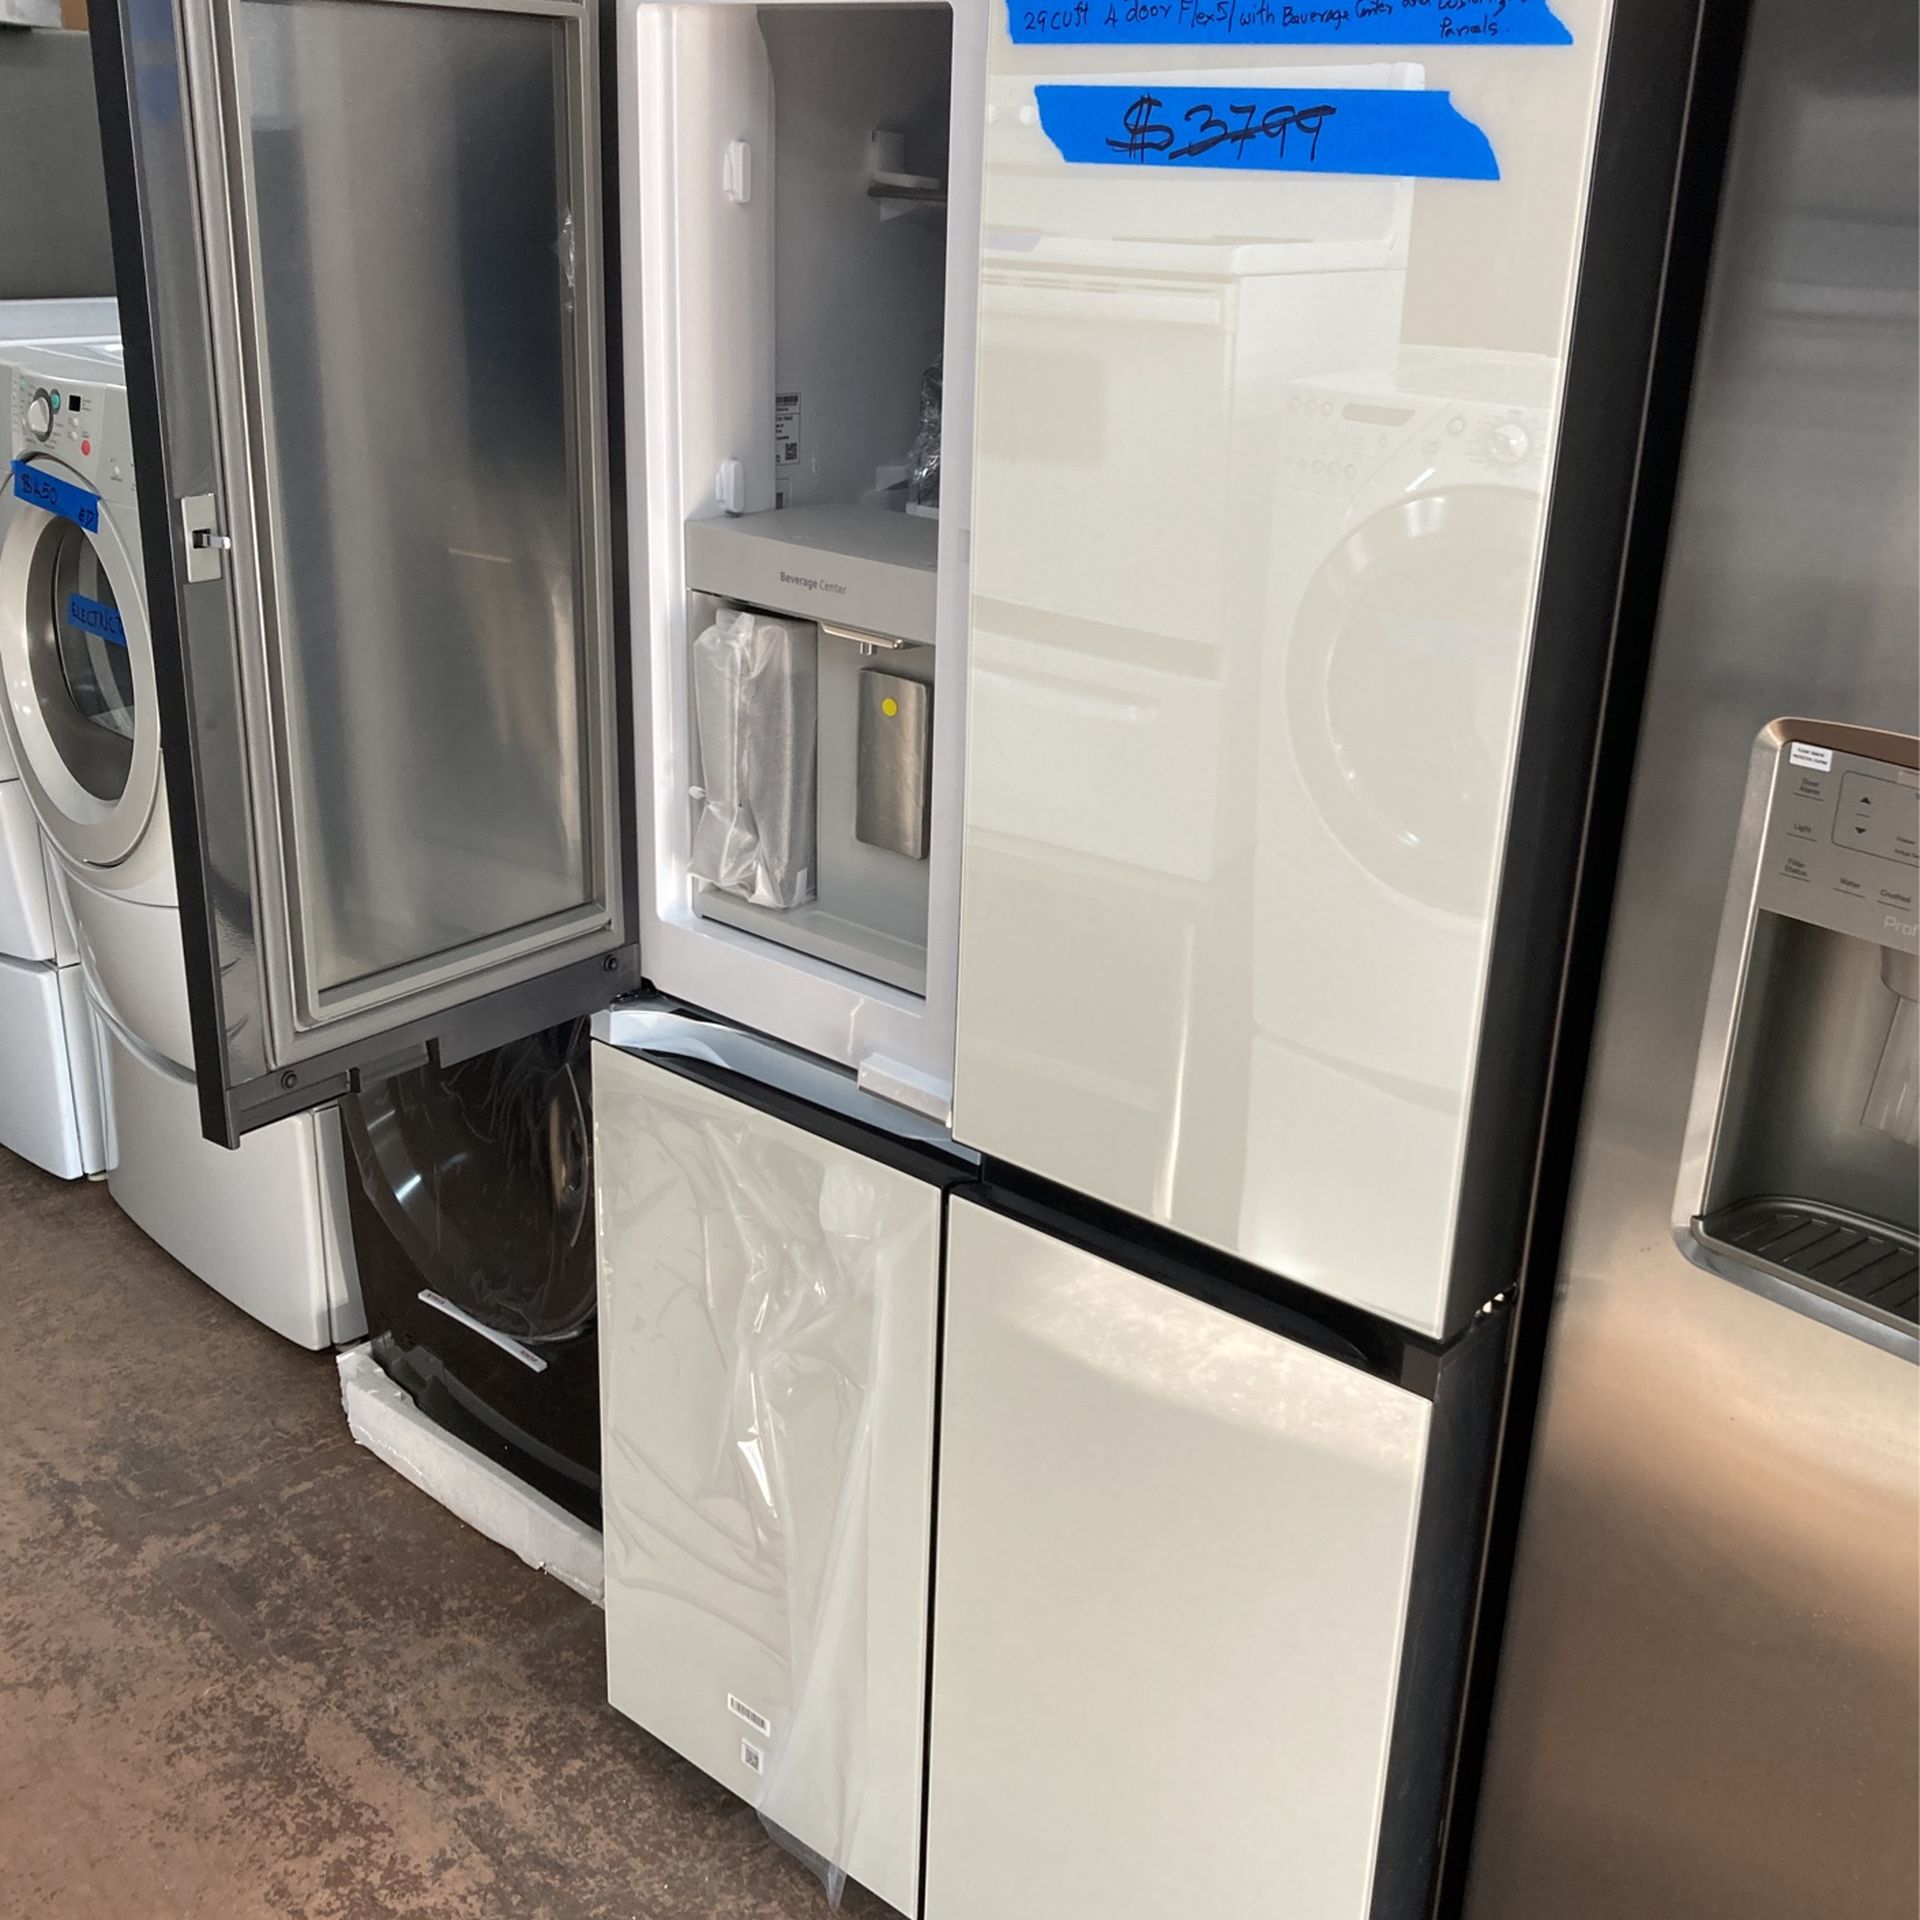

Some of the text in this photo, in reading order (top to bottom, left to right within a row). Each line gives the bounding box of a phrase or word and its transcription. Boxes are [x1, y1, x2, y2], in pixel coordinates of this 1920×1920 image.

[1125, 0, 1172, 23] door
[1241, 0, 1276, 27] with
[780, 571, 847, 595] Beverage Center
